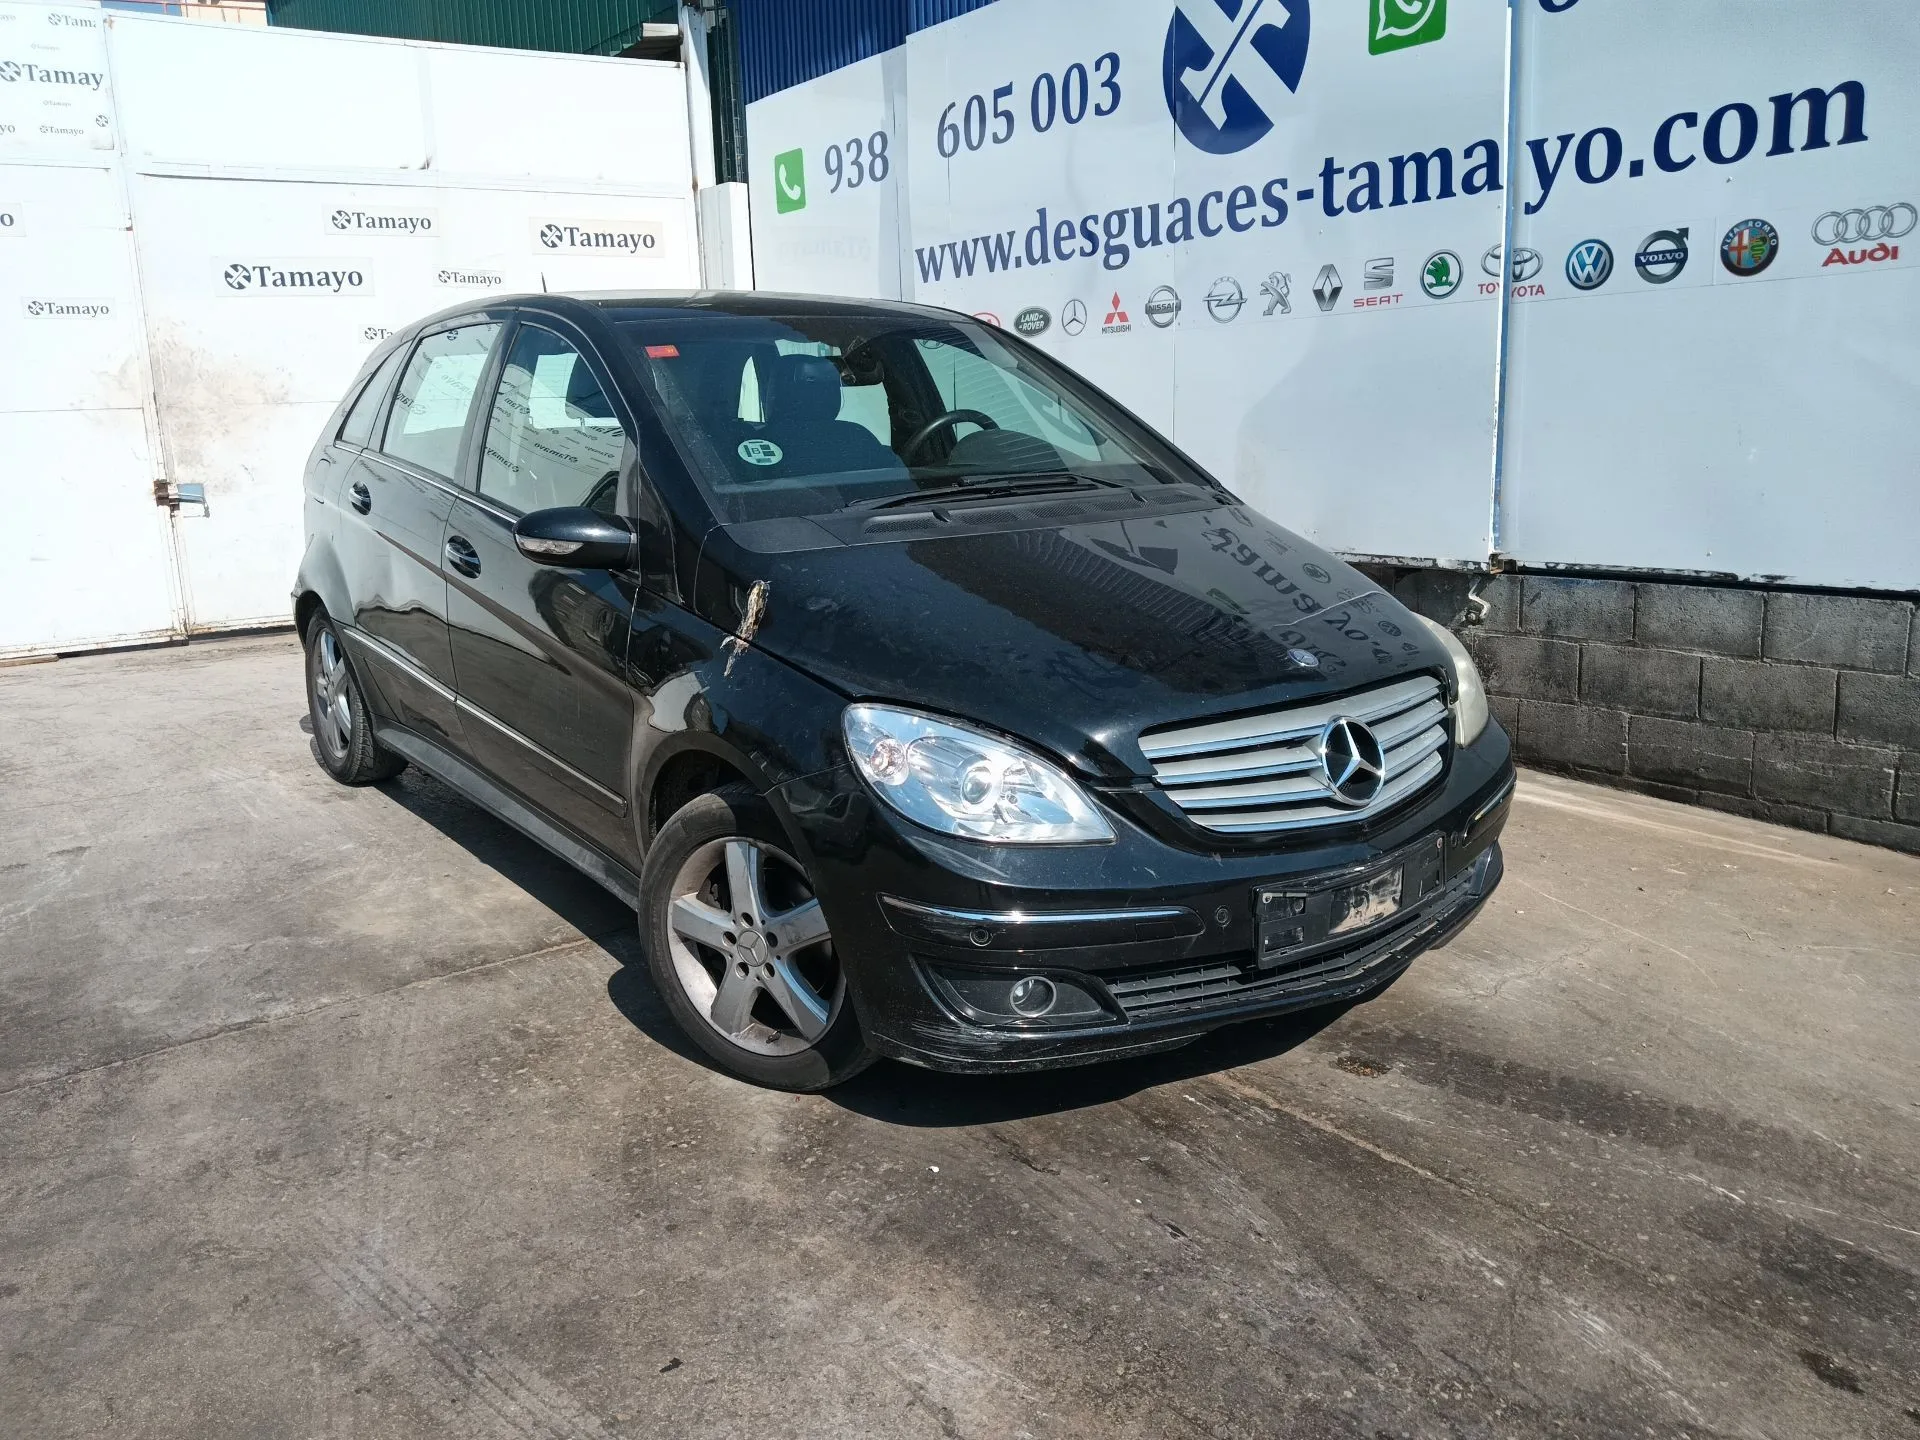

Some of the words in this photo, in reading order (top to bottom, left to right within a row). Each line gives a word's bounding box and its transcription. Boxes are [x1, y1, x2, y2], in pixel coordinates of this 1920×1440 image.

[824, 130, 890, 193] 938
[937, 82, 1015, 158] 605
[1031, 52, 1122, 134] 003
[49, 126, 84, 136] Tamayo
[352, 212, 432, 234] Tamayo
[564, 226, 656, 254] Tamayo
[1722, 226, 1741, 250] ALFA
[1748, 221, 1777, 246] ROMEO
[1639, 251, 1685, 264] VOLVO
[1822, 244, 1899, 267] Audi
[253, 265, 363, 293] Tamayo
[450, 272, 502, 286] Tamayo
[1353, 294, 1403, 308] SEAT
[45, 302, 110, 318] Tamayo
[1021, 313, 1039, 323] LAND
[1023, 321, 1045, 331] ROVER
[1101, 324, 1132, 334] MITSUBISHI
